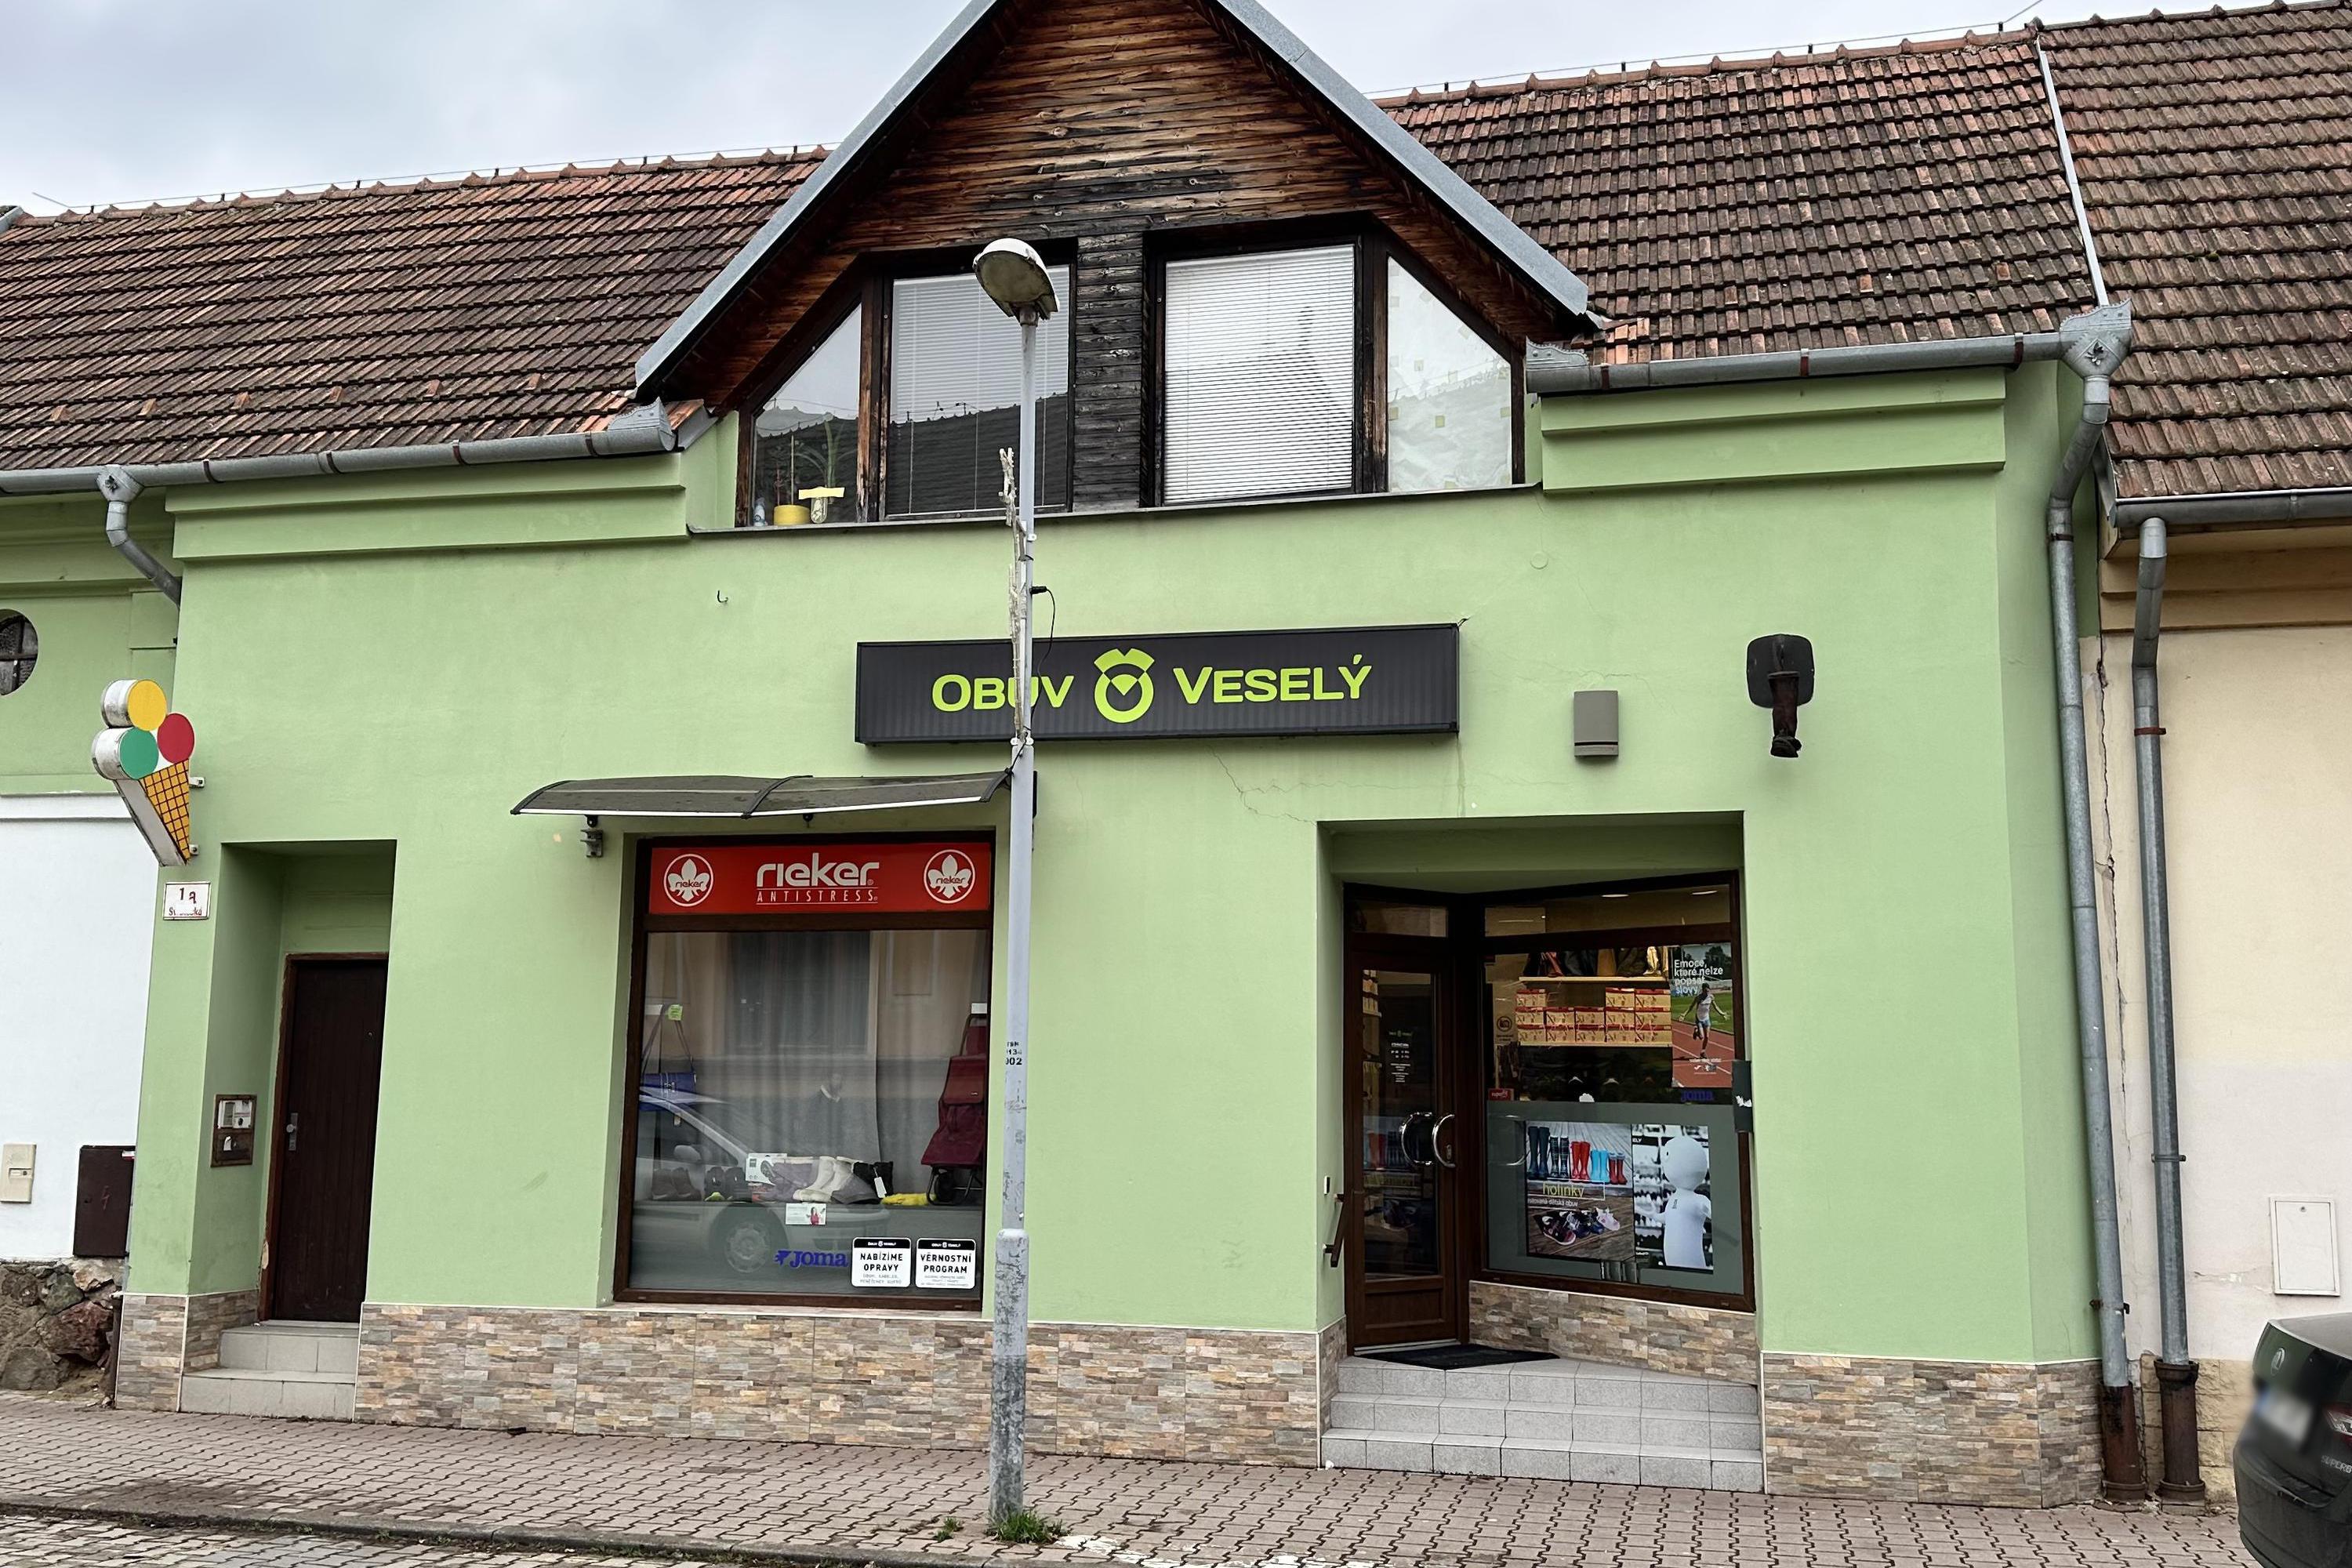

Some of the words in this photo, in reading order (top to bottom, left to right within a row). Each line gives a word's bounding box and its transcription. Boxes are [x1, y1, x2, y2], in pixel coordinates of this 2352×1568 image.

[932, 674, 1075, 712] OBUV
[1174, 654, 1372, 704] VESELÝ
[757, 852, 880, 887] rieker
[676, 879, 704, 887] rieker
[936, 875, 965, 884] rieker
[757, 889, 873, 902] ANTISTRESS
[1542, 1181, 1584, 1198] holinky
[860, 1250, 903, 1261] NABÍZÍME
[920, 1252, 971, 1263] VĚRNOSTNÍ
[863, 1263, 898, 1272] OPRAVY
[924, 1265, 967, 1273] PROGRAM
